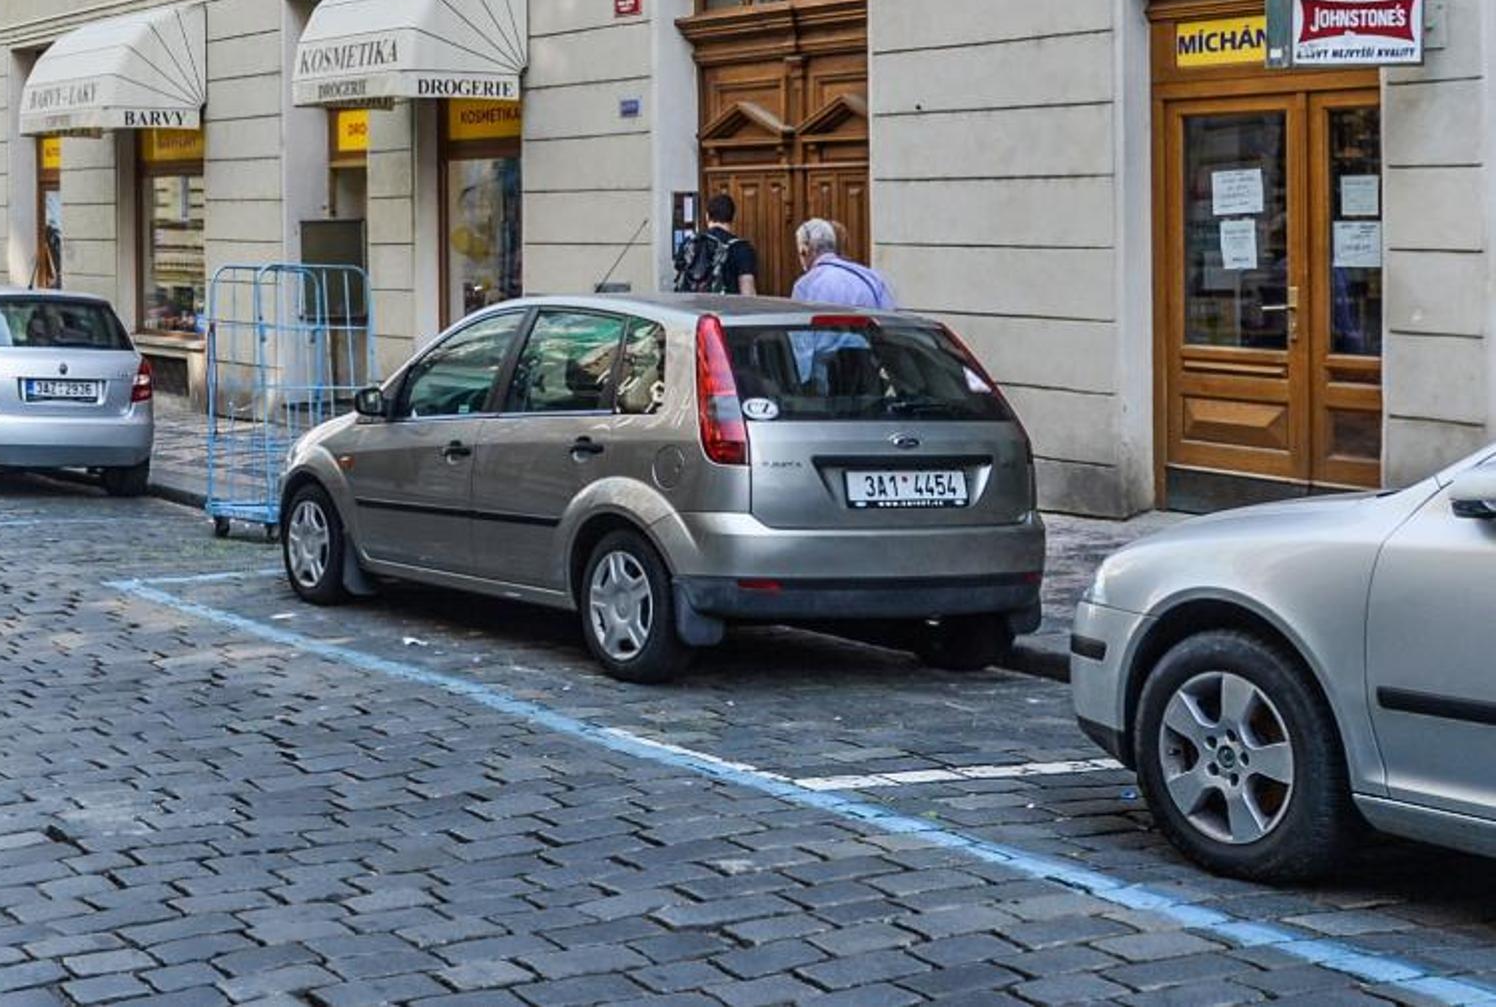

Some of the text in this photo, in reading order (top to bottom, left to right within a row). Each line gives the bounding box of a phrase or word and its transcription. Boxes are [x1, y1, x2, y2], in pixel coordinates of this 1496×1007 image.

[1309, 3, 1407, 32] JOHNSTONE'S
[300, 39, 399, 75] KOSMETIKA
[1377, 46, 1415, 58] KVALITY
[417, 78, 514, 98] DROGERIE
[124, 110, 186, 127] BARVY
[747, 401, 772, 416] CZ
[864, 474, 957, 498] 3A1 4454
